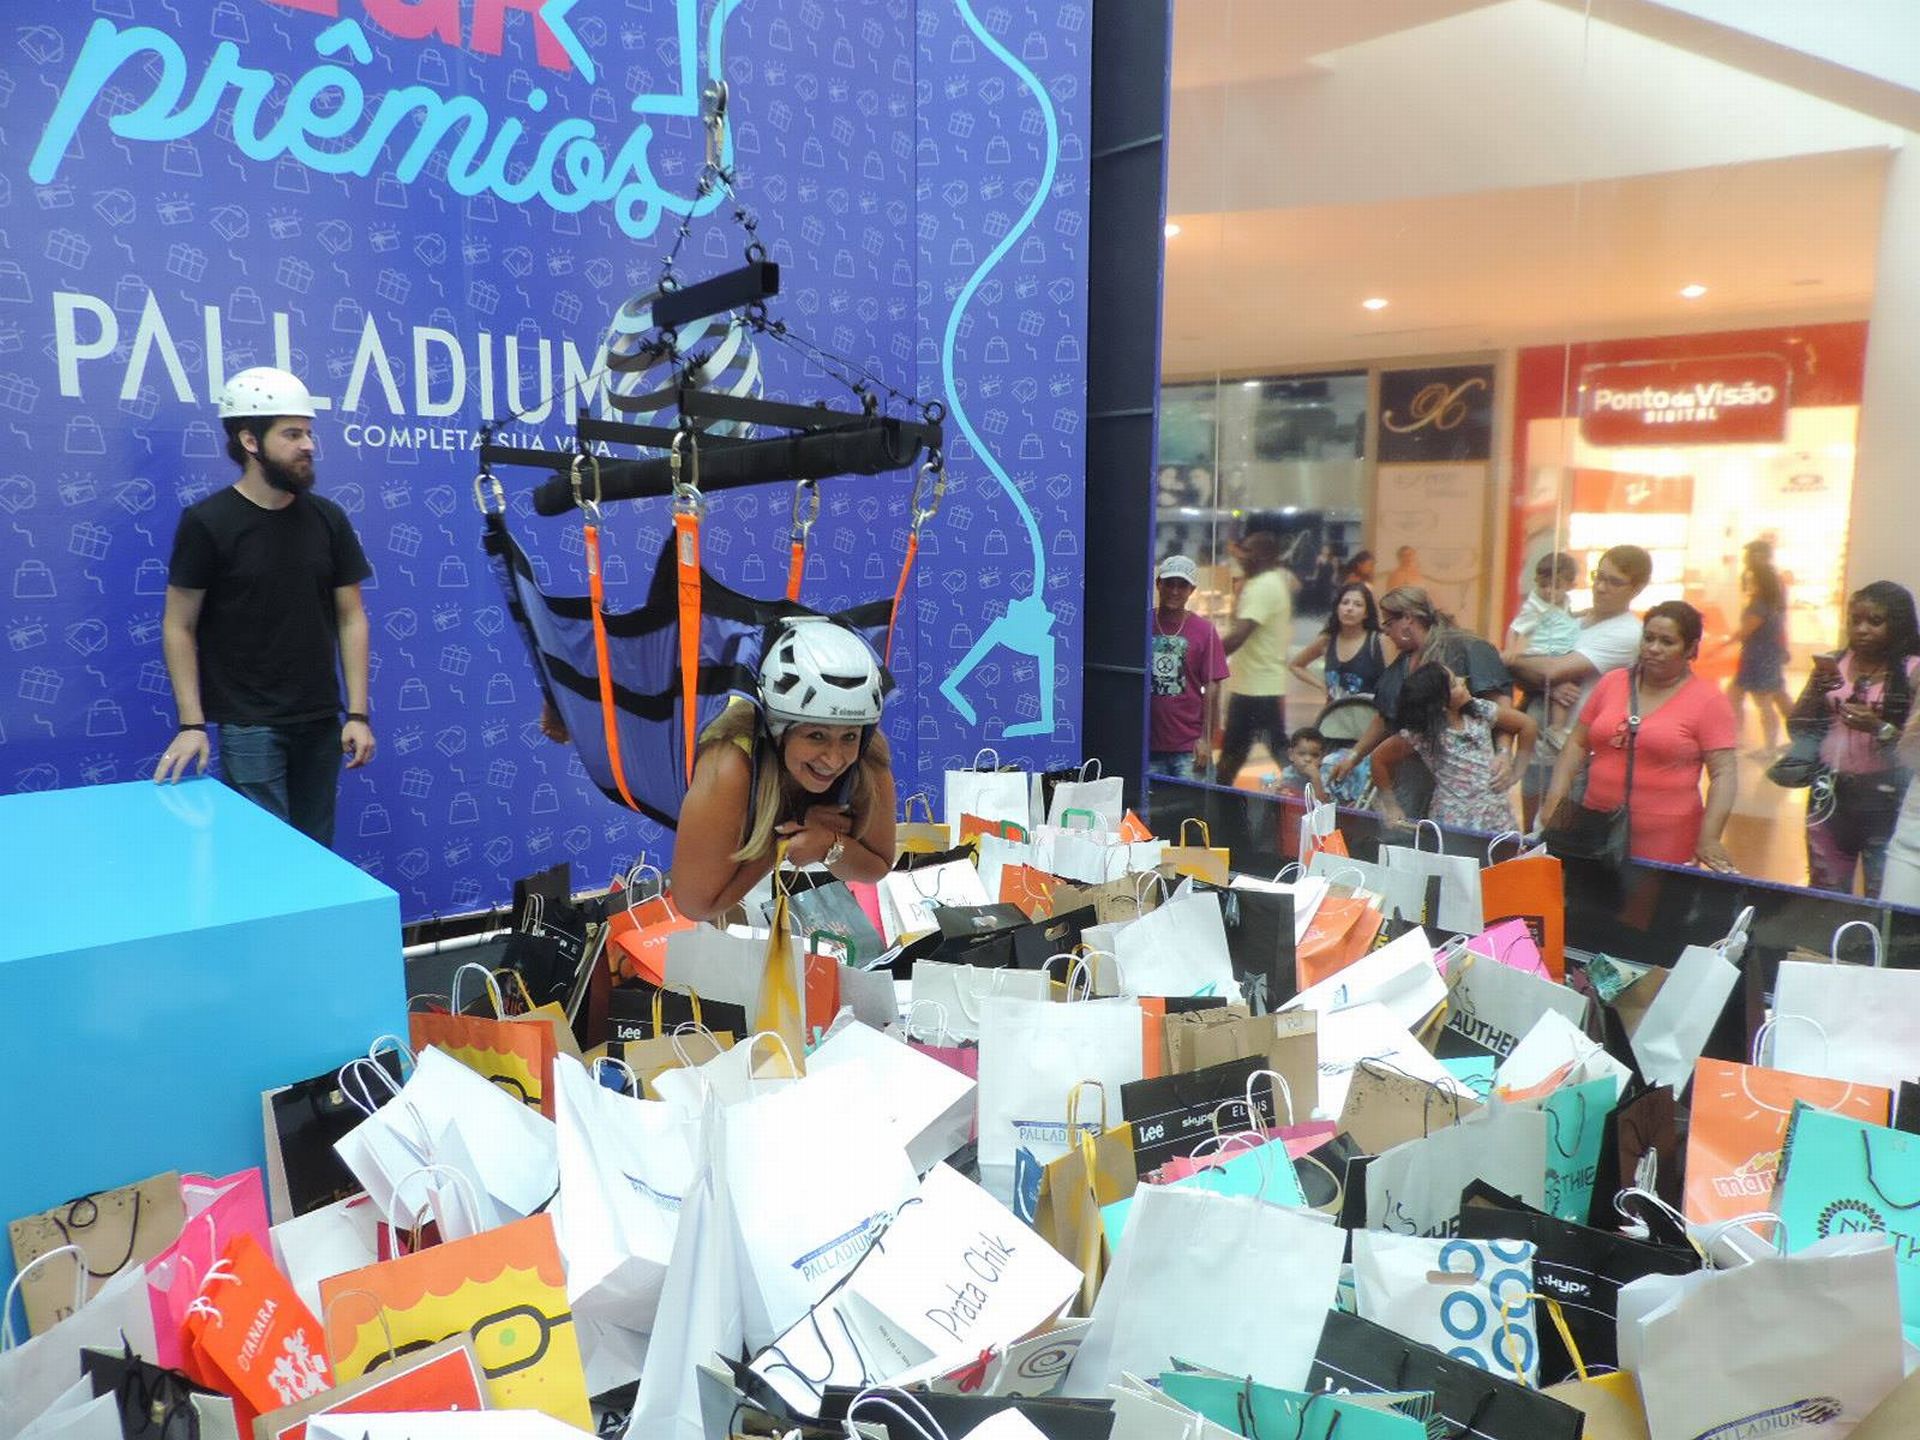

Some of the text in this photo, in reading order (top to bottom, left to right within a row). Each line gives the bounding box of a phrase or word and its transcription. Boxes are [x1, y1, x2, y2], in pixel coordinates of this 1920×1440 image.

[28, 18, 706, 239] prêmios
[52, 289, 622, 427] PALLADIUM
[1594, 387, 1670, 411] Ponto
[1694, 381, 1777, 406] Visão
[1643, 407, 1719, 424] DIGITAL
[617, 1025, 642, 1039] Lee
[1140, 1124, 1164, 1144] Lee
[1232, 1101, 1268, 1118] ELUS
[925, 1231, 1016, 1343] Prata Chik
